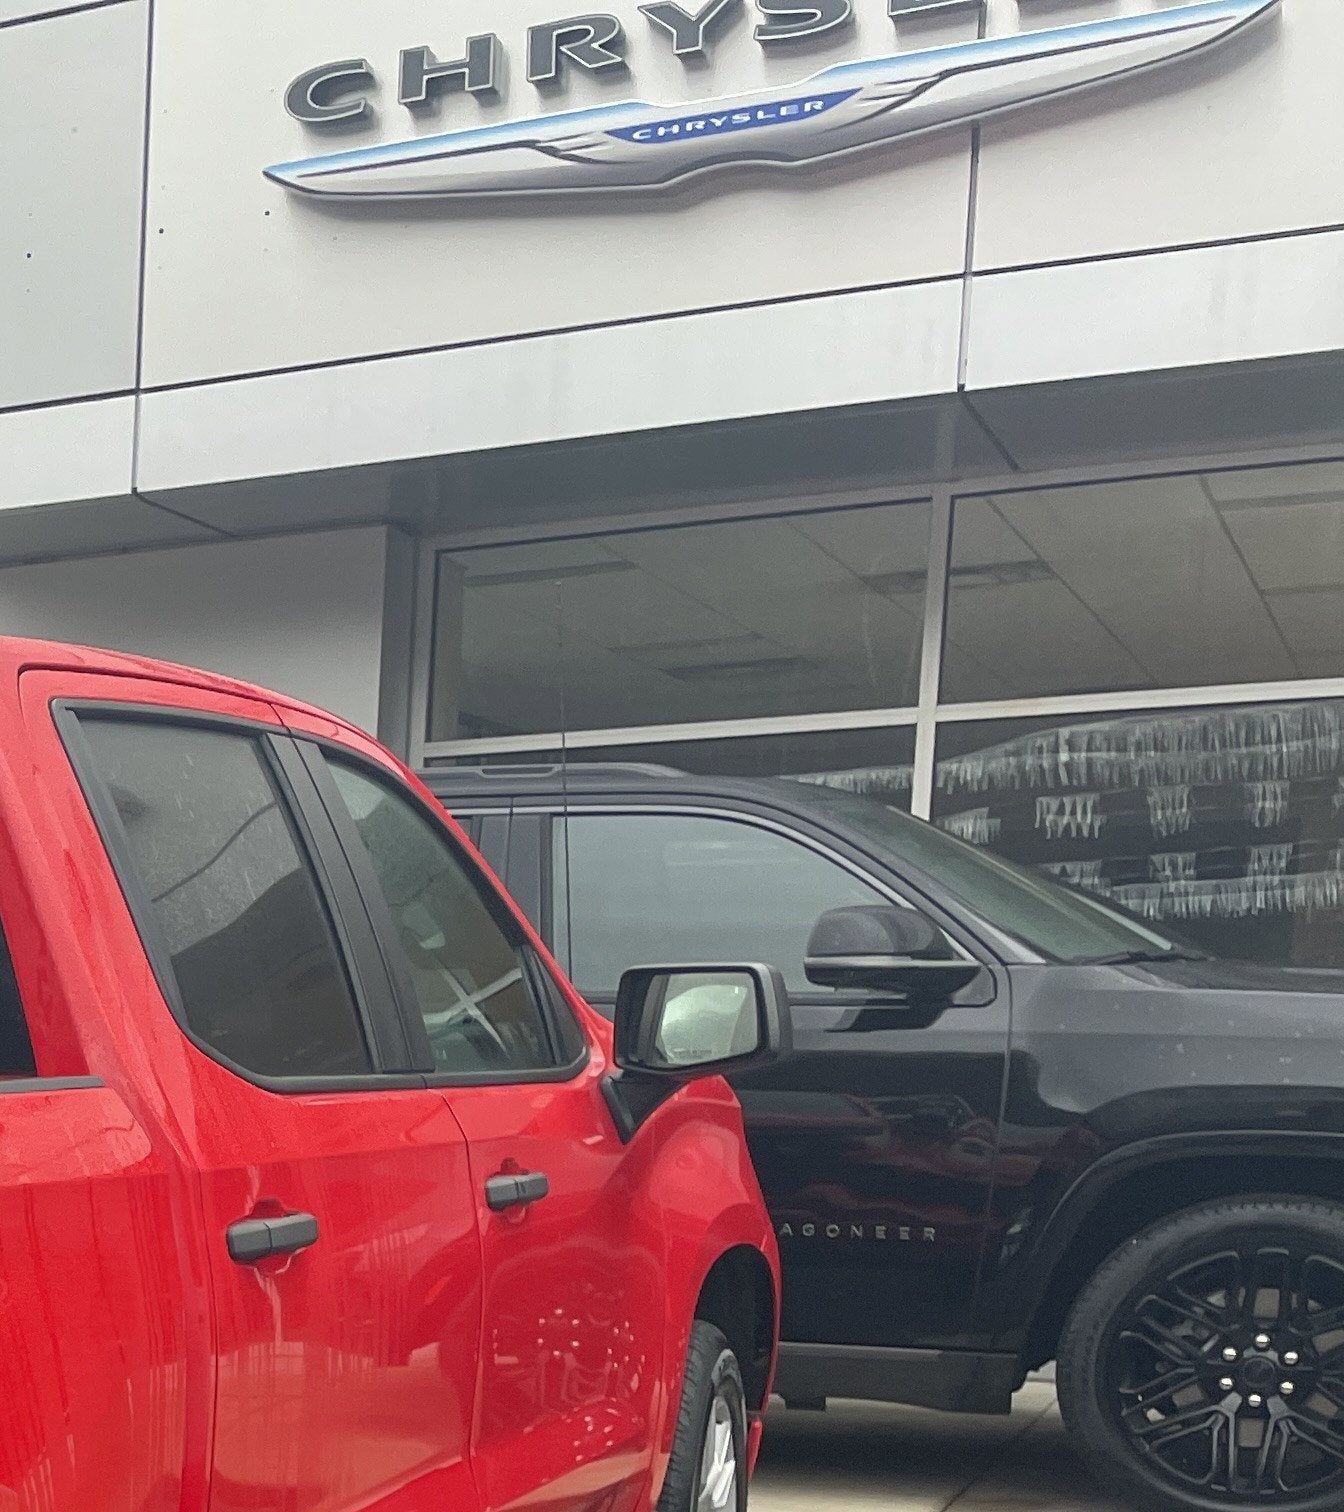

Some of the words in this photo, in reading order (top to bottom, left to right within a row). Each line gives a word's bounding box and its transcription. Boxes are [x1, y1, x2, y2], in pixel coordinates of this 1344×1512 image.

[283, 0, 984, 122] CHRYS
[632, 100, 825, 141] CHRYSLER
[779, 1222, 936, 1243] AGONEER
